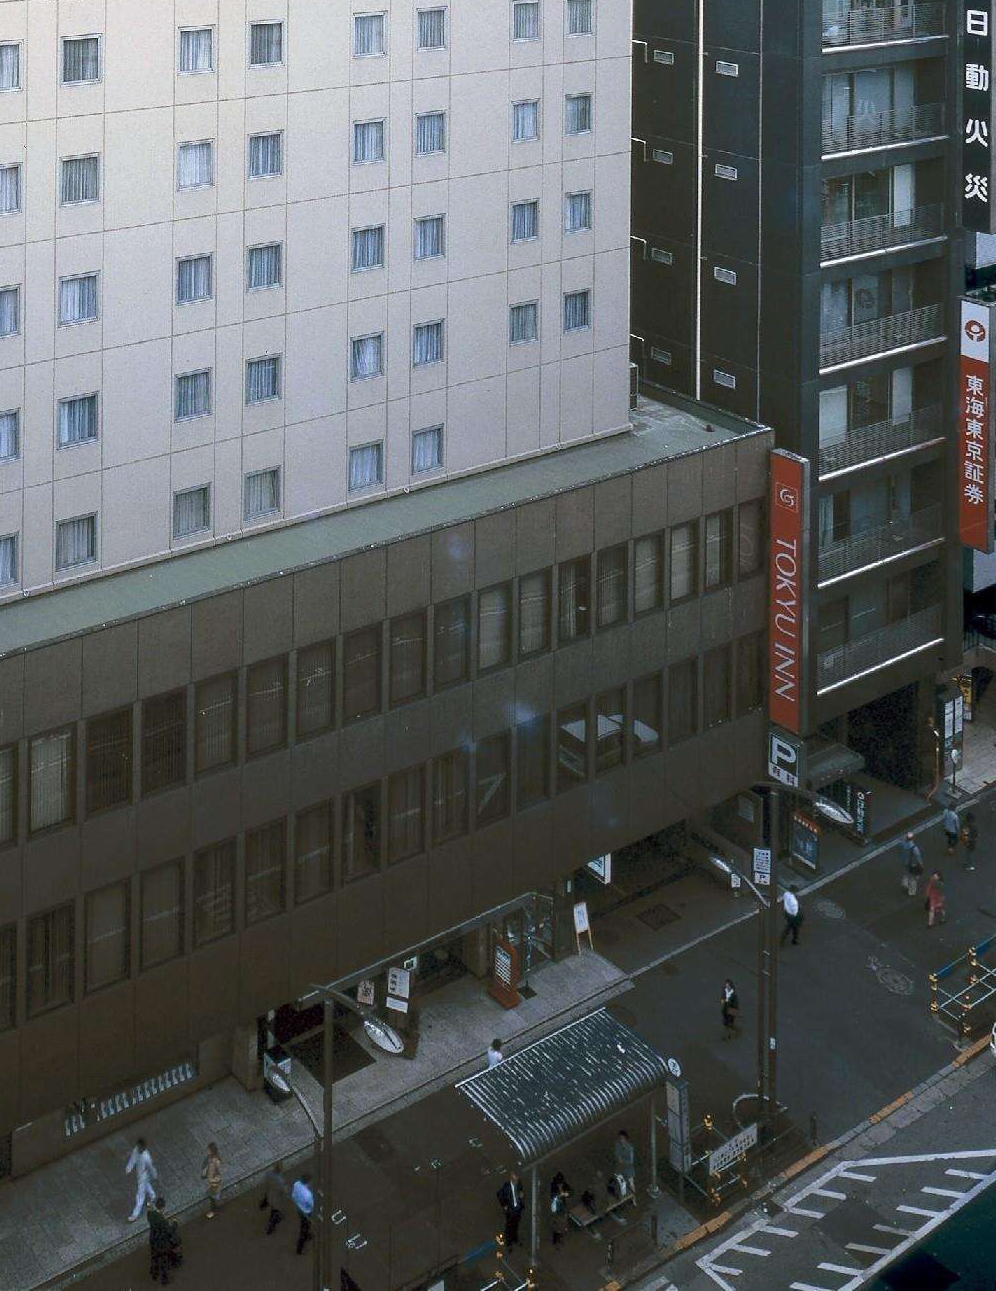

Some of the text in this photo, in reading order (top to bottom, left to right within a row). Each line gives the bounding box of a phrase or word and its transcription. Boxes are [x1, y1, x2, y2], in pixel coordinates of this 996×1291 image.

[965, 8, 989, 203] 日動火災
[964, 374, 985, 505] 東海東京証券
[774, 539, 797, 702] TOKYU INN
[771, 735, 797, 765] P
